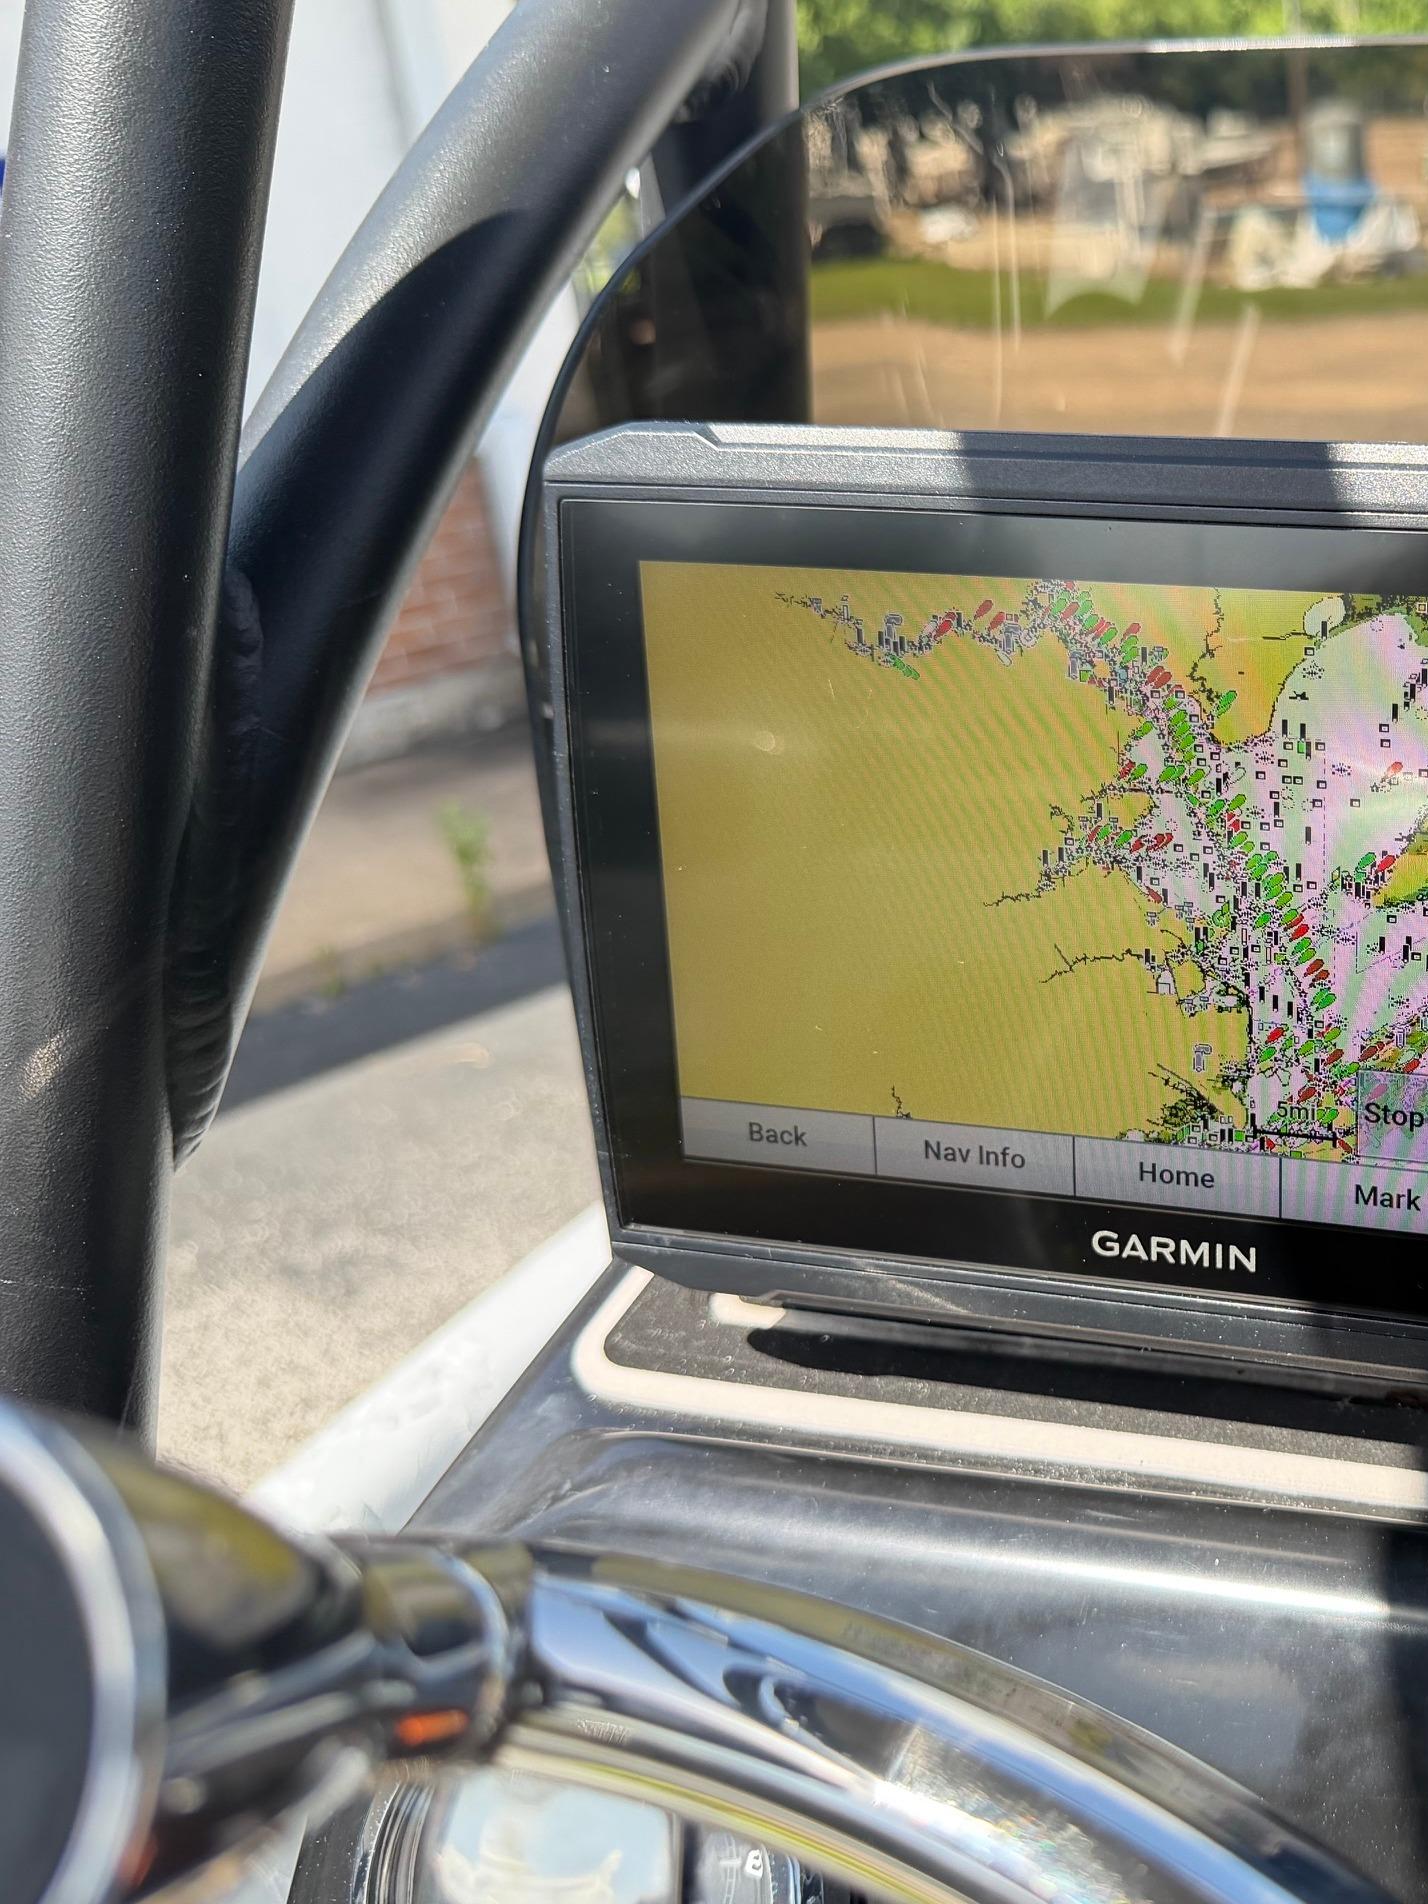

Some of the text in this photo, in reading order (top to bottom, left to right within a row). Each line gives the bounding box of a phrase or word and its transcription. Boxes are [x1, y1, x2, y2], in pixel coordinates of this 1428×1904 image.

[1276, 1100, 1316, 1122] 5mi
[1364, 1101, 1425, 1131] Stop
[747, 1120, 808, 1148] Back
[924, 1139, 1027, 1171] Nav Info
[1138, 1161, 1216, 1190] Home
[1353, 1182, 1422, 1213] Mark
[1090, 1228, 1258, 1274] GARMIN
